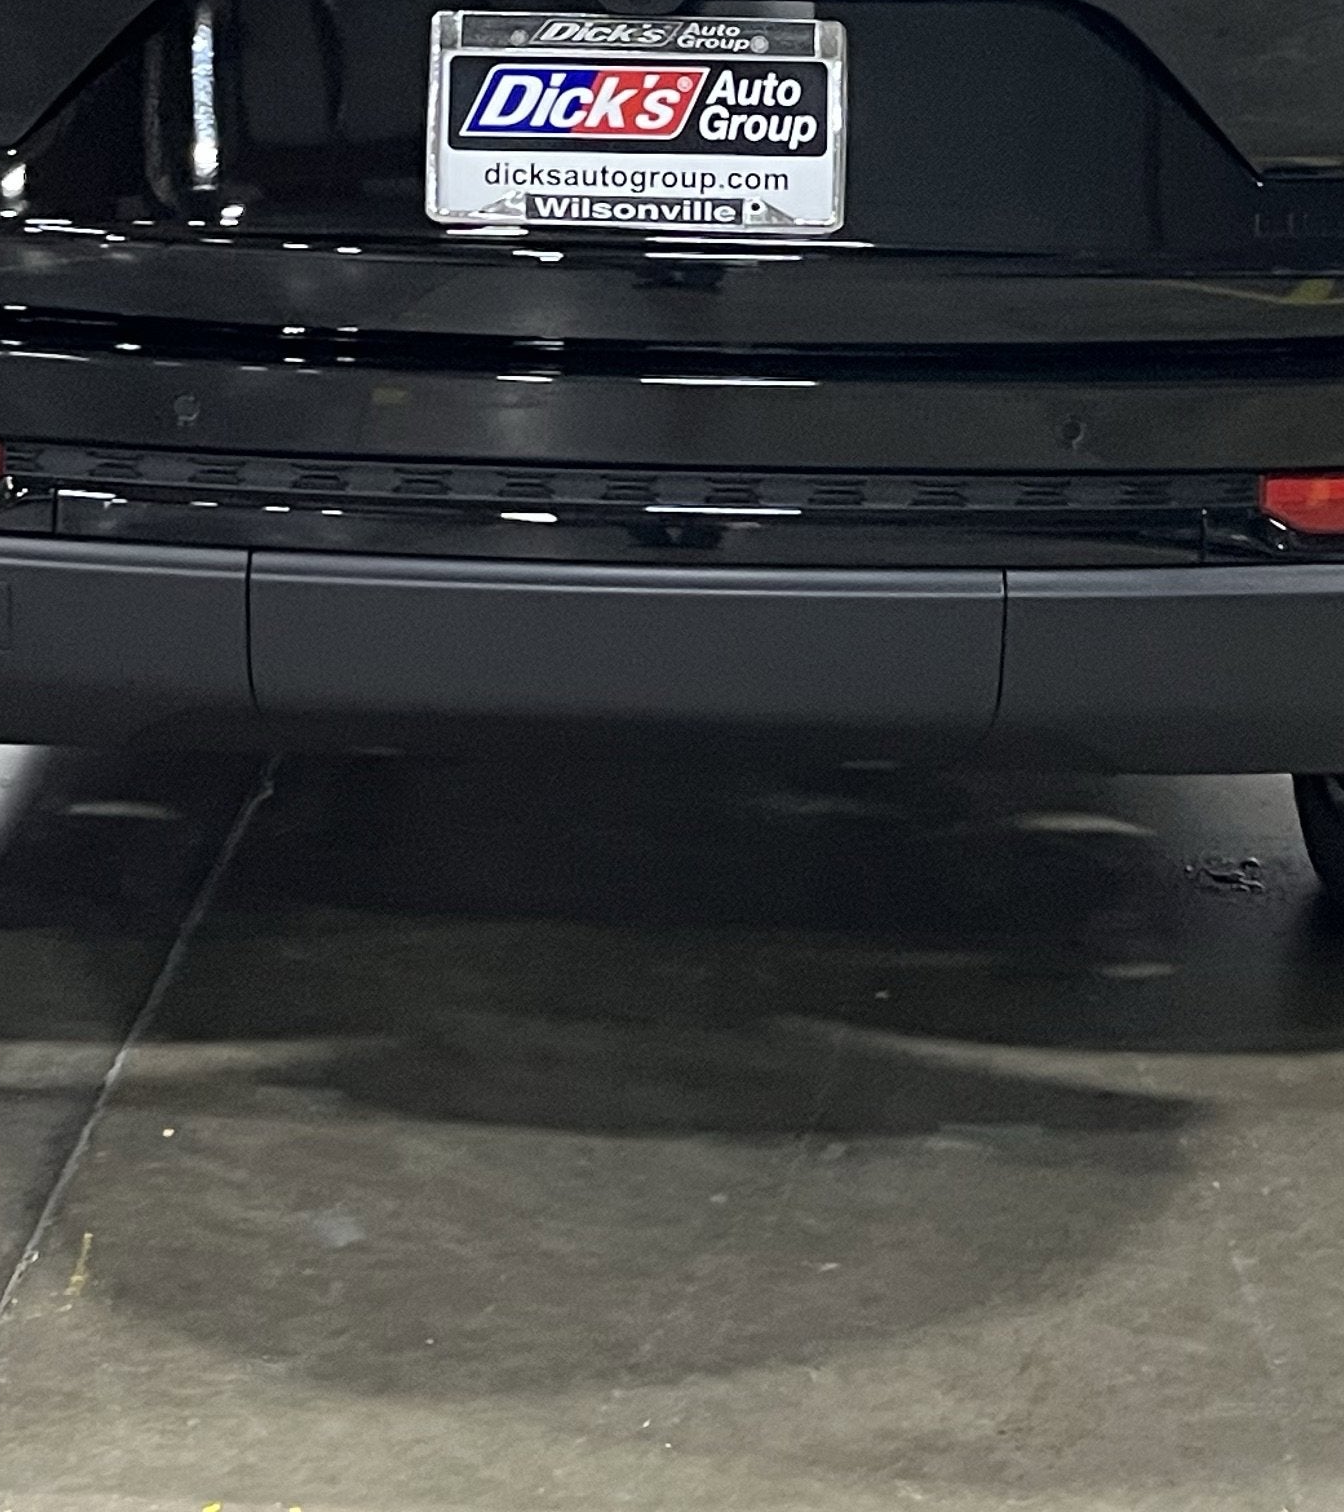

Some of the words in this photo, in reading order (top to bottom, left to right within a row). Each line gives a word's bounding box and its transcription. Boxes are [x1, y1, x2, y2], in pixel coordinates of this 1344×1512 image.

[539, 21, 666, 44] Dick's
[676, 34, 751, 52] Group
[684, 22, 741, 37] Auto
[477, 72, 682, 132] Dick's
[705, 69, 802, 108] Auto
[698, 105, 818, 150] Group
[483, 162, 789, 194] dicksautogroup.com
[534, 197, 737, 224] Wilsonville
